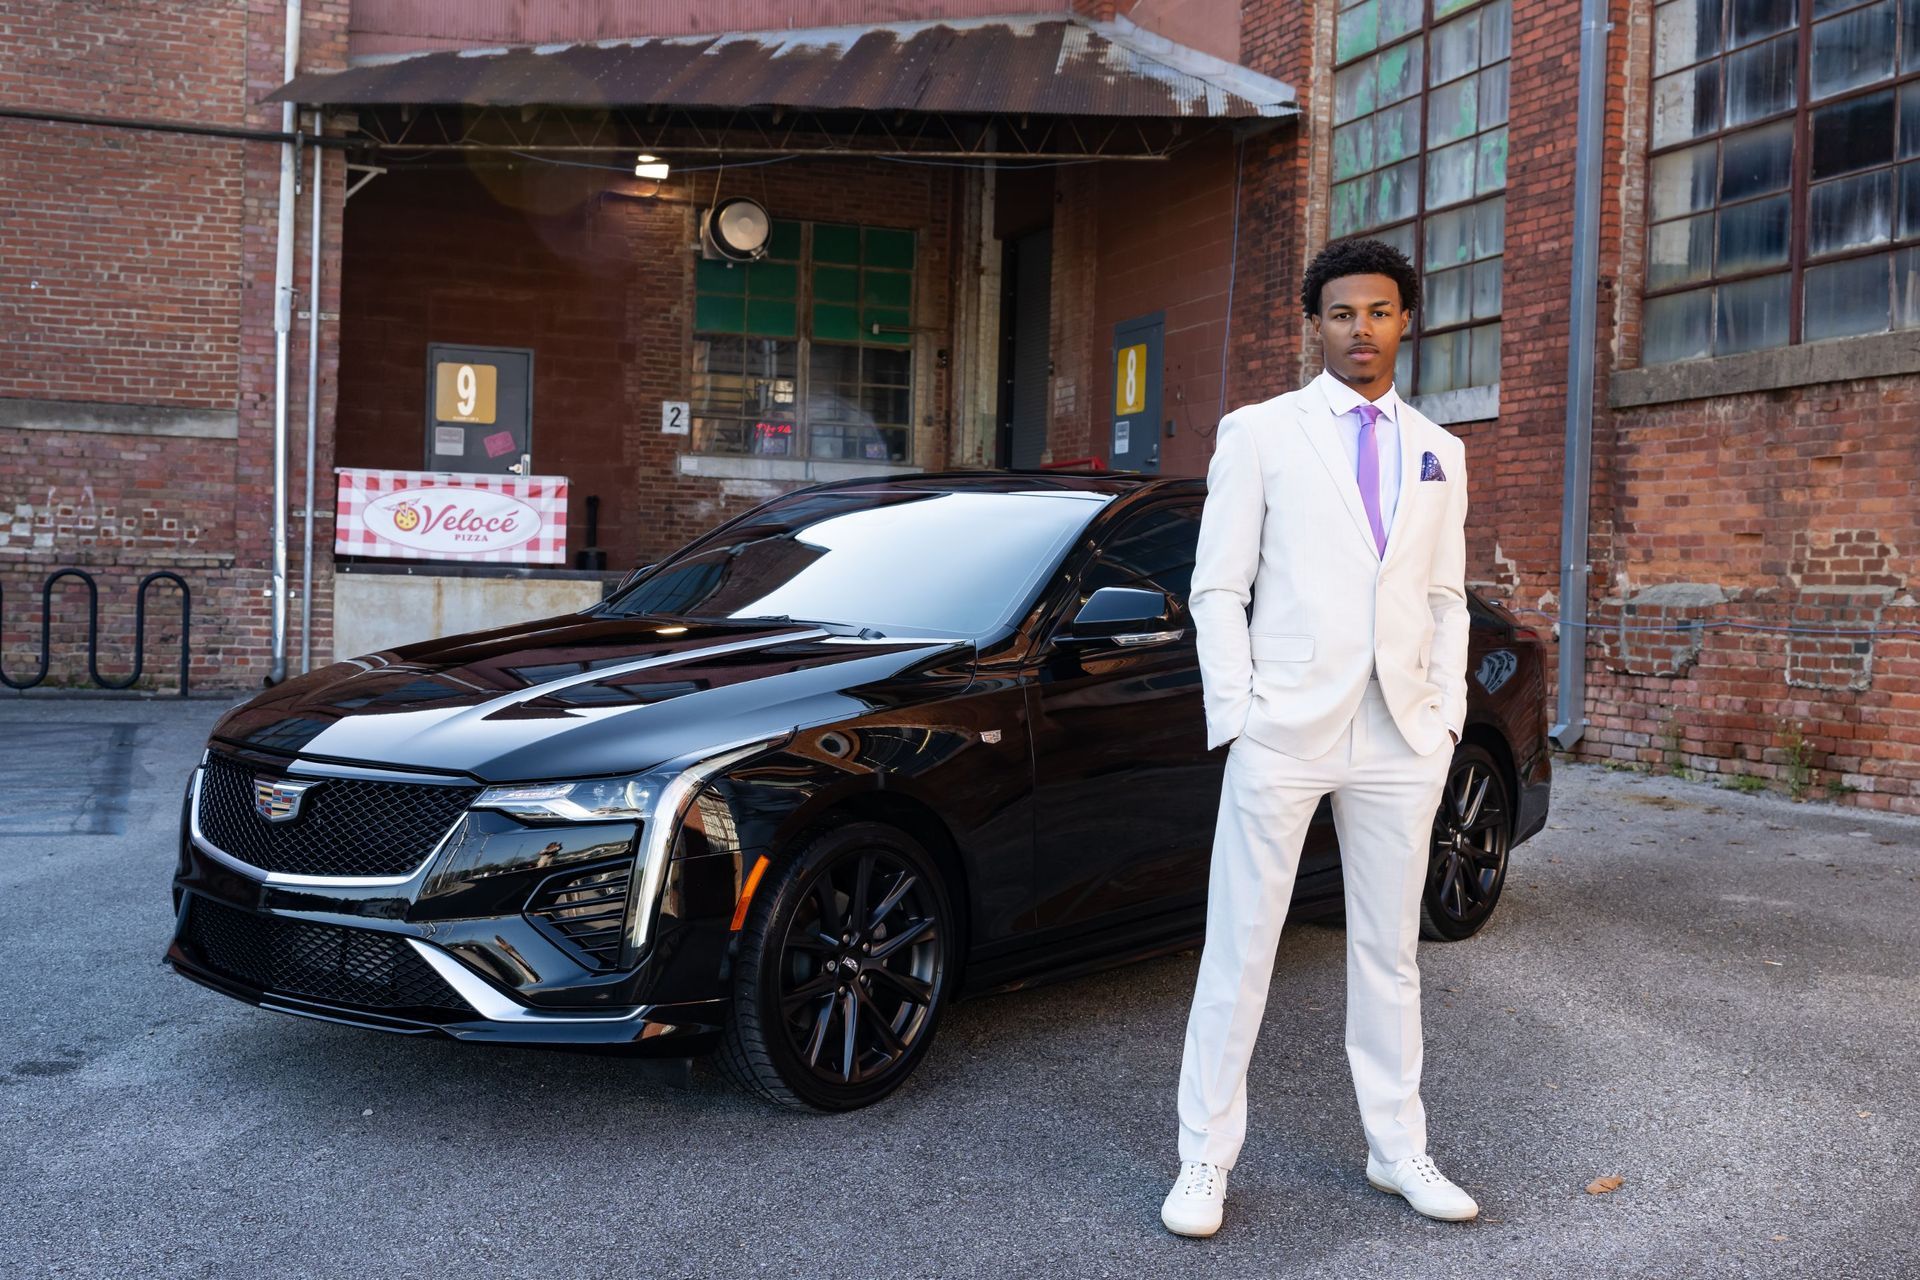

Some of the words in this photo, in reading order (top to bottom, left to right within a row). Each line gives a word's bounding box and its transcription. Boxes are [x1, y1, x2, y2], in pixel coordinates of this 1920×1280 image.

[457, 365, 476, 416] 9
[1126, 349, 1136, 406] 8
[670, 406, 681, 427] 2
[421, 504, 519, 535] Velocé
[454, 533, 489, 542] PIZZA
